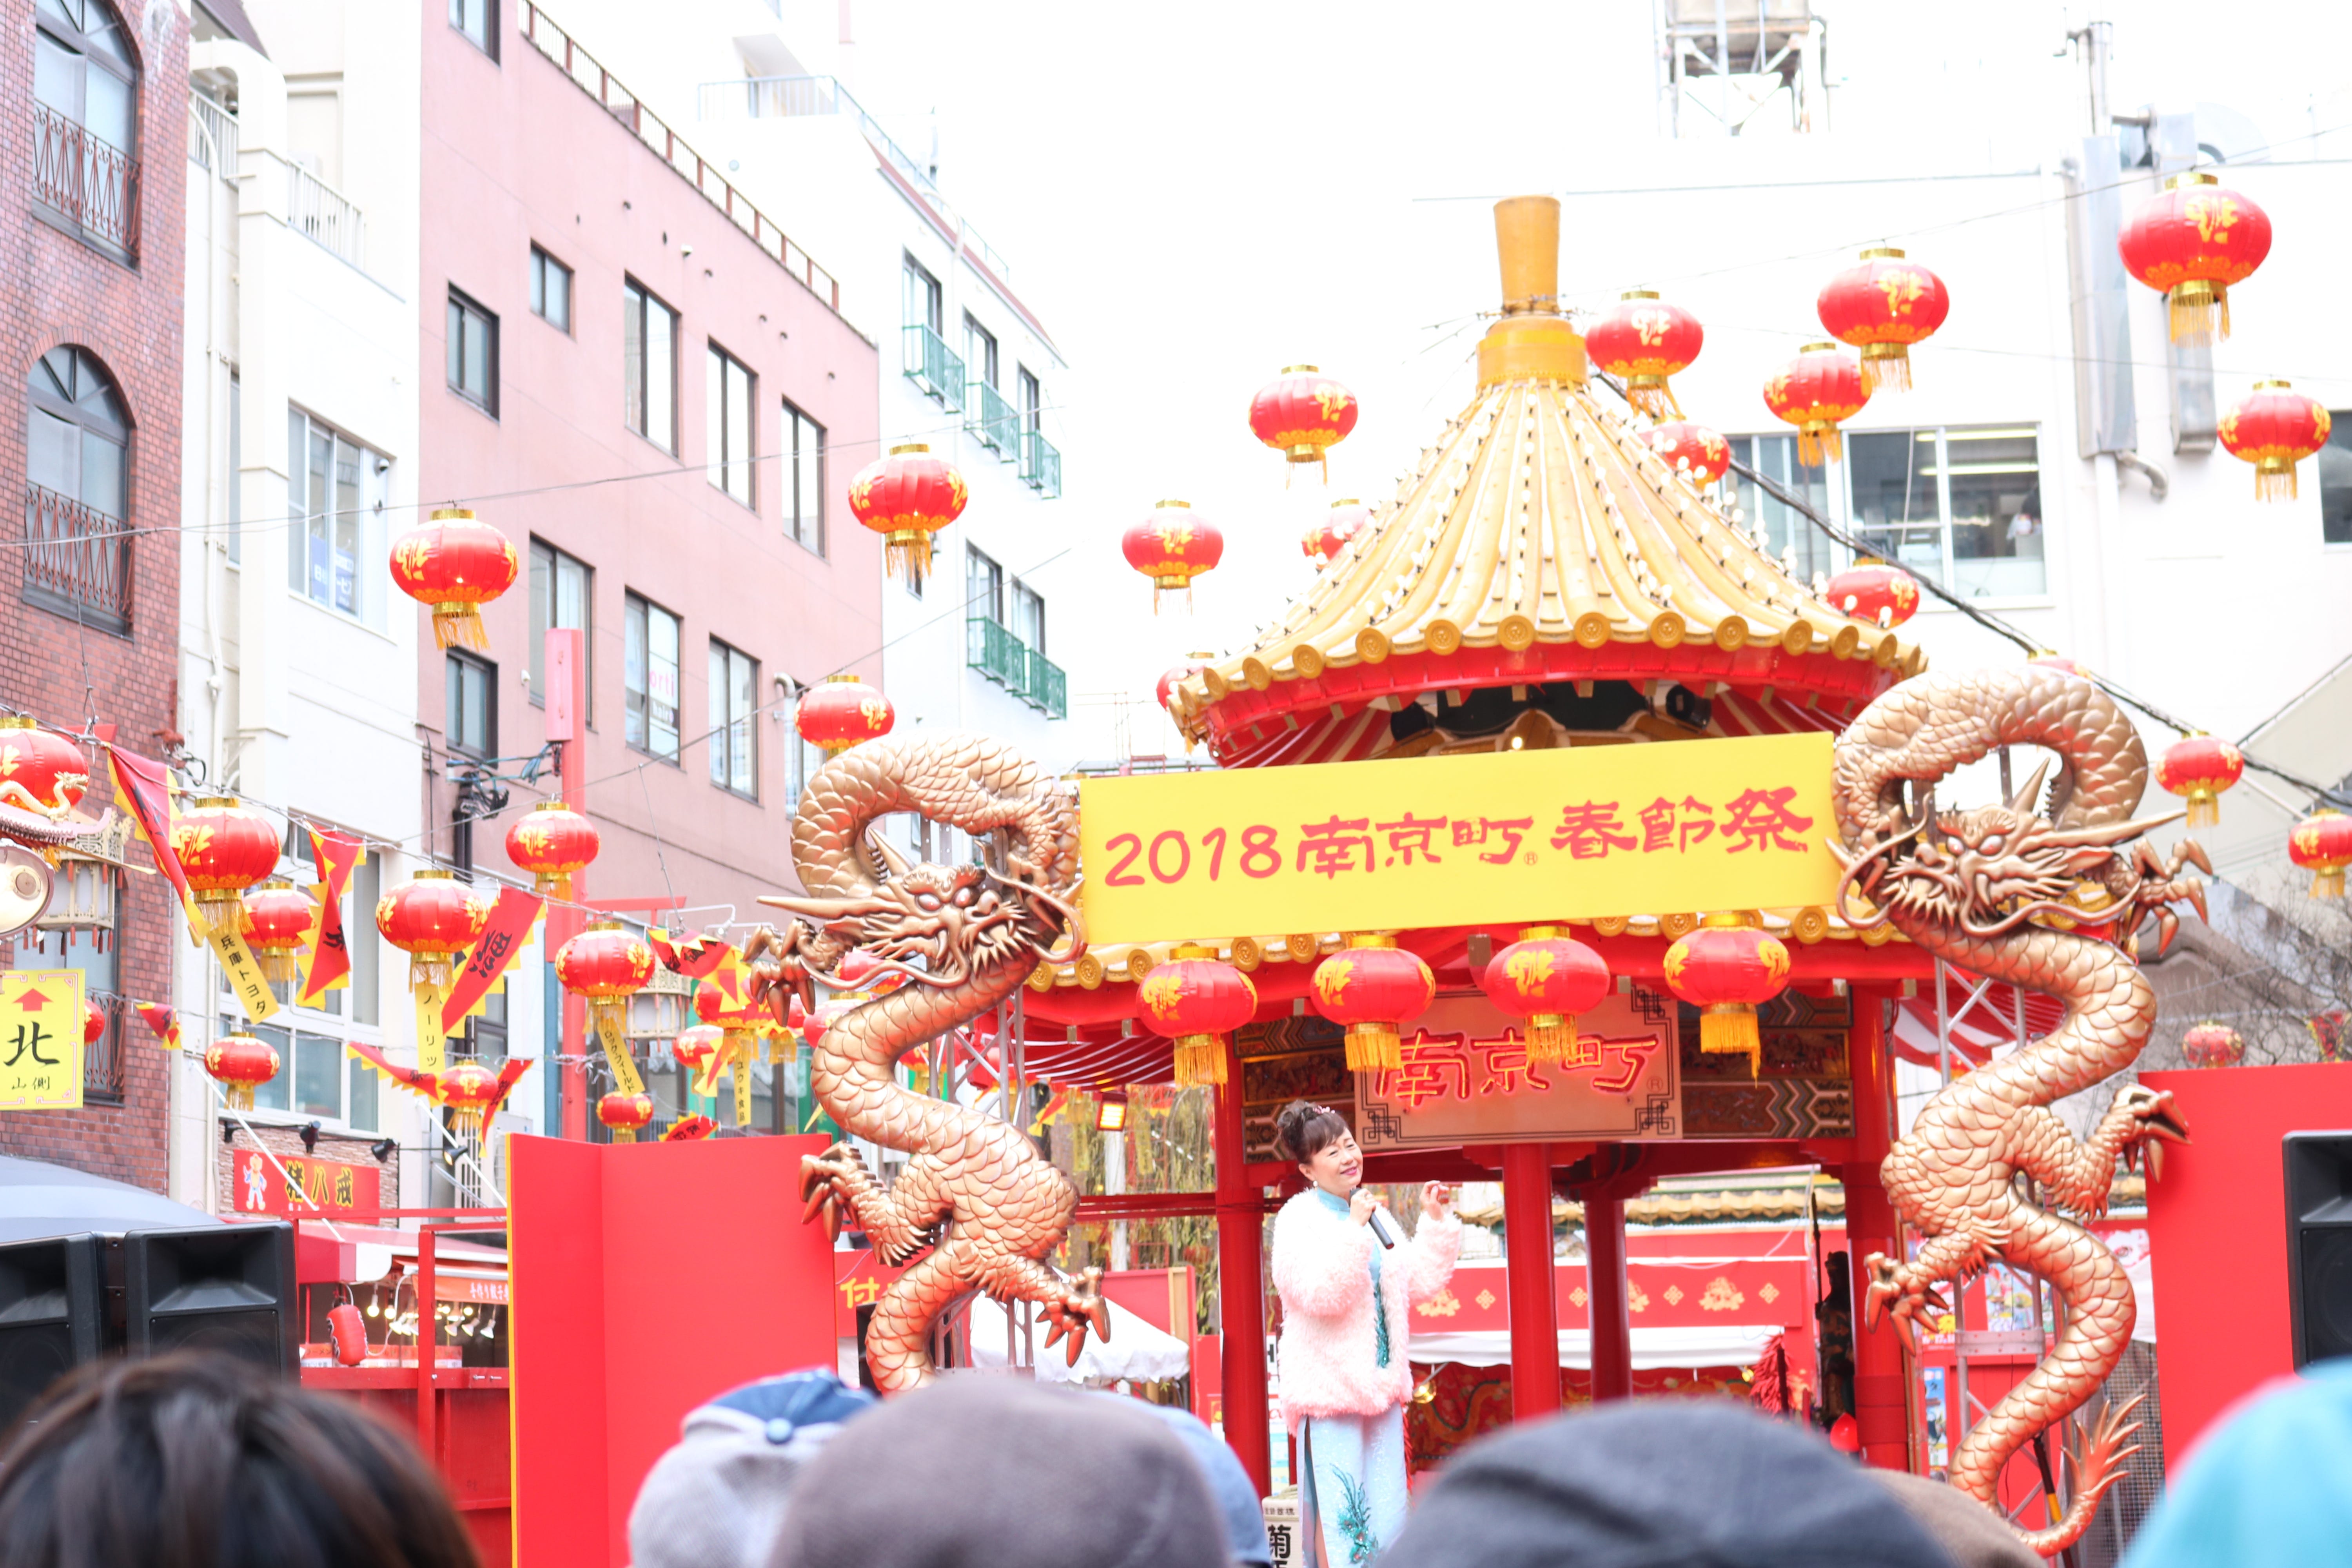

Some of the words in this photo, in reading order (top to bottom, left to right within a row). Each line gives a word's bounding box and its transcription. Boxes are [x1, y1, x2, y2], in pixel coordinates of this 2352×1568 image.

[221, 935, 266, 1014] 兵庫トヨタ
[4, 1020, 60, 1069] 北
[424, 995, 437, 1067] ノーリツ
[11, 1076, 50, 1091] 山側
[737, 1062, 745, 1122] ユウキ食品
[1268, 1524, 1291, 1568] 菊
